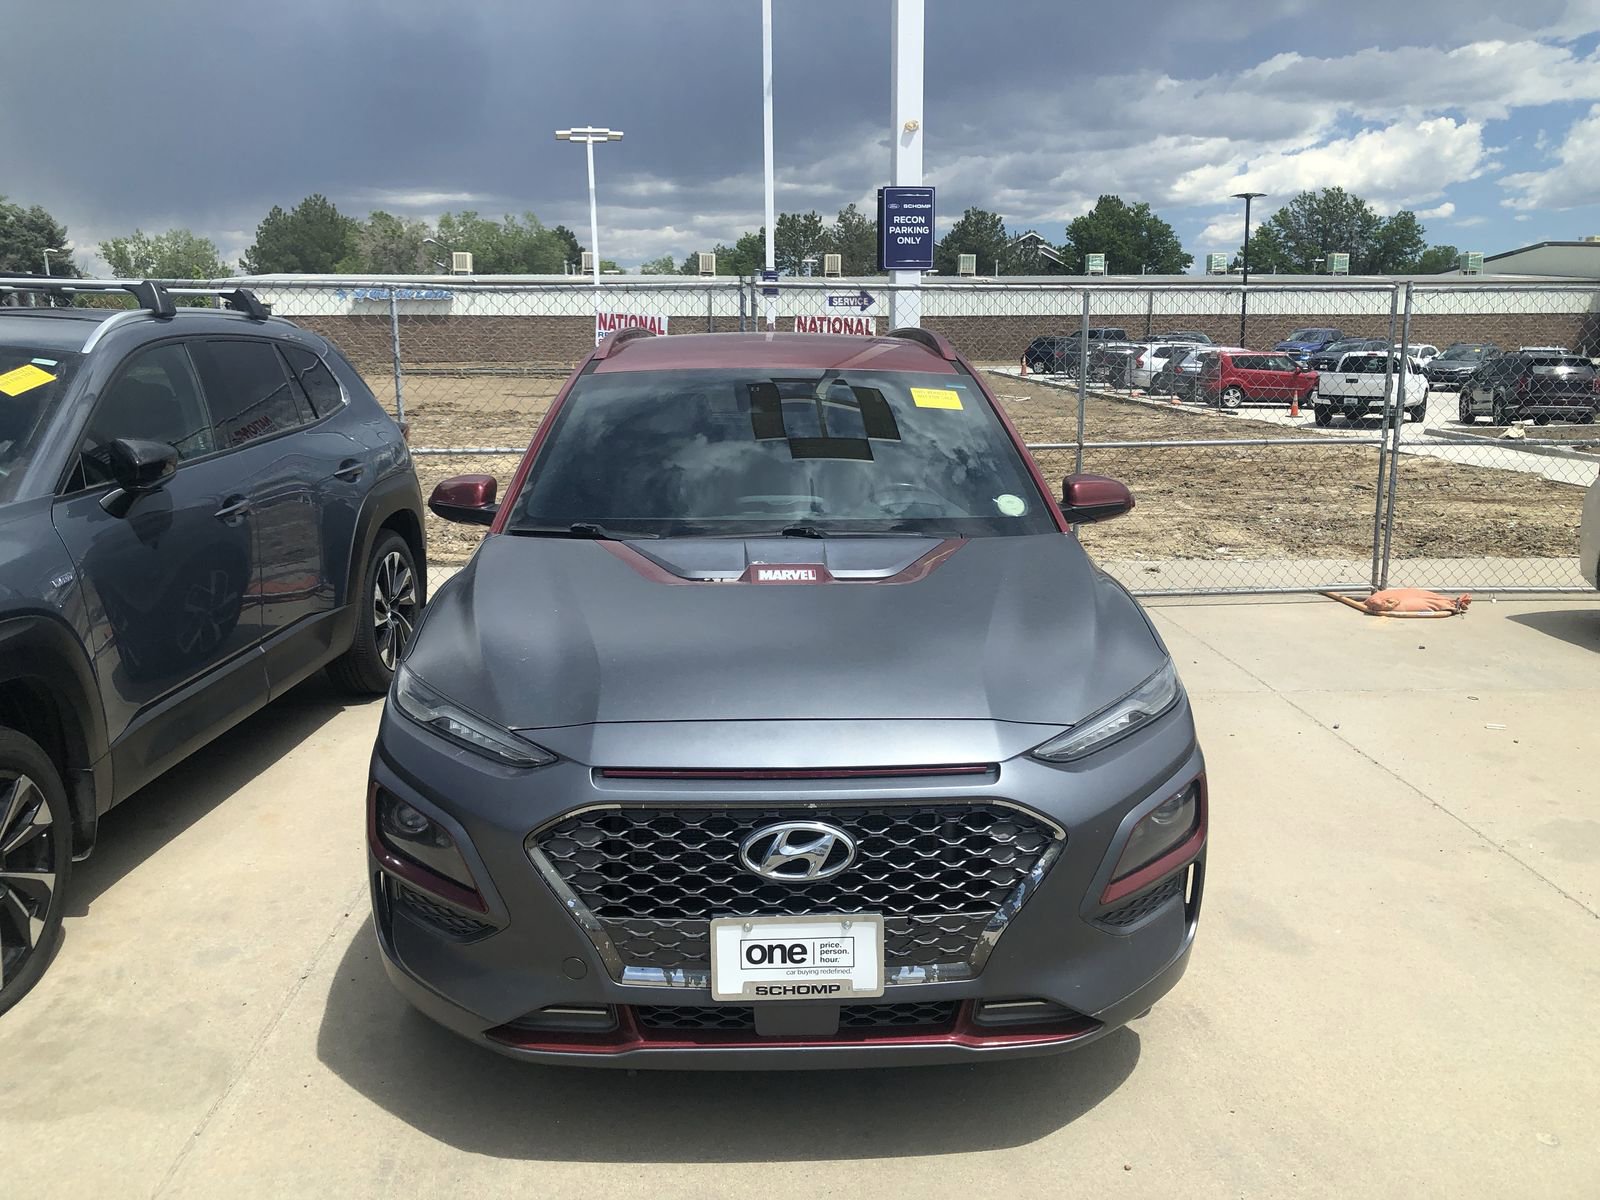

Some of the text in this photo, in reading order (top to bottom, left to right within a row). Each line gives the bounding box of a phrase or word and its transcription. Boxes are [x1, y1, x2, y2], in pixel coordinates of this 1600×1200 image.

[893, 215, 925, 224] RECON
[889, 226, 929, 234] PARKING
[897, 236, 921, 245] ONLY
[832, 297, 869, 306] SERVICE
[598, 312, 665, 335] NATIONAL
[797, 315, 873, 336] NATIONAL
[758, 569, 816, 581] MARVEL
[819, 941, 842, 949] price.
[745, 943, 807, 964] one
[797, 968, 819, 976] buying
[820, 967, 852, 975] redefined.
[756, 984, 840, 995] SCHOMP
